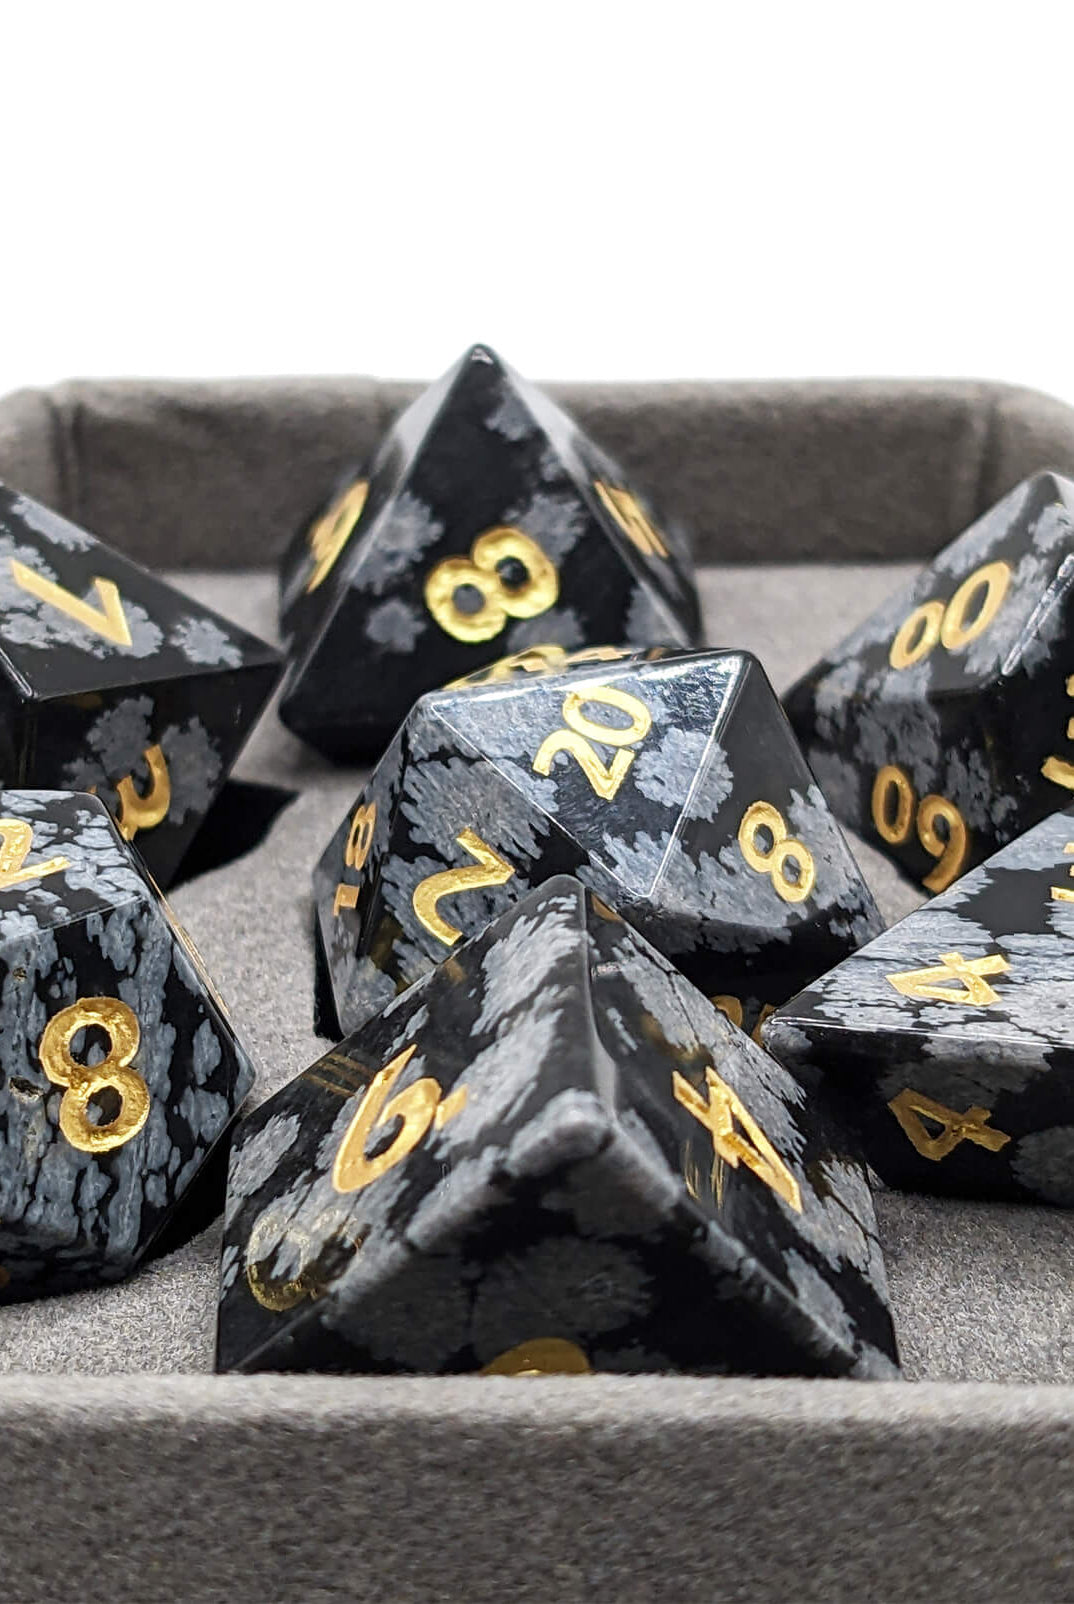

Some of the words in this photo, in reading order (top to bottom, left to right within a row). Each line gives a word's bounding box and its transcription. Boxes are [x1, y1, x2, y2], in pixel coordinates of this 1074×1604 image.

[424, 525, 560, 643] 8
[889, 562, 1012, 669] 00
[532, 686, 652, 801] 20
[333, 803, 376, 917] 18
[738, 800, 815, 903] 8
[886, 952, 1012, 1007] 4
[38, 996, 150, 1154] 8
[888, 1088, 1012, 1161] 4
[672, 1066, 802, 1214] 4
